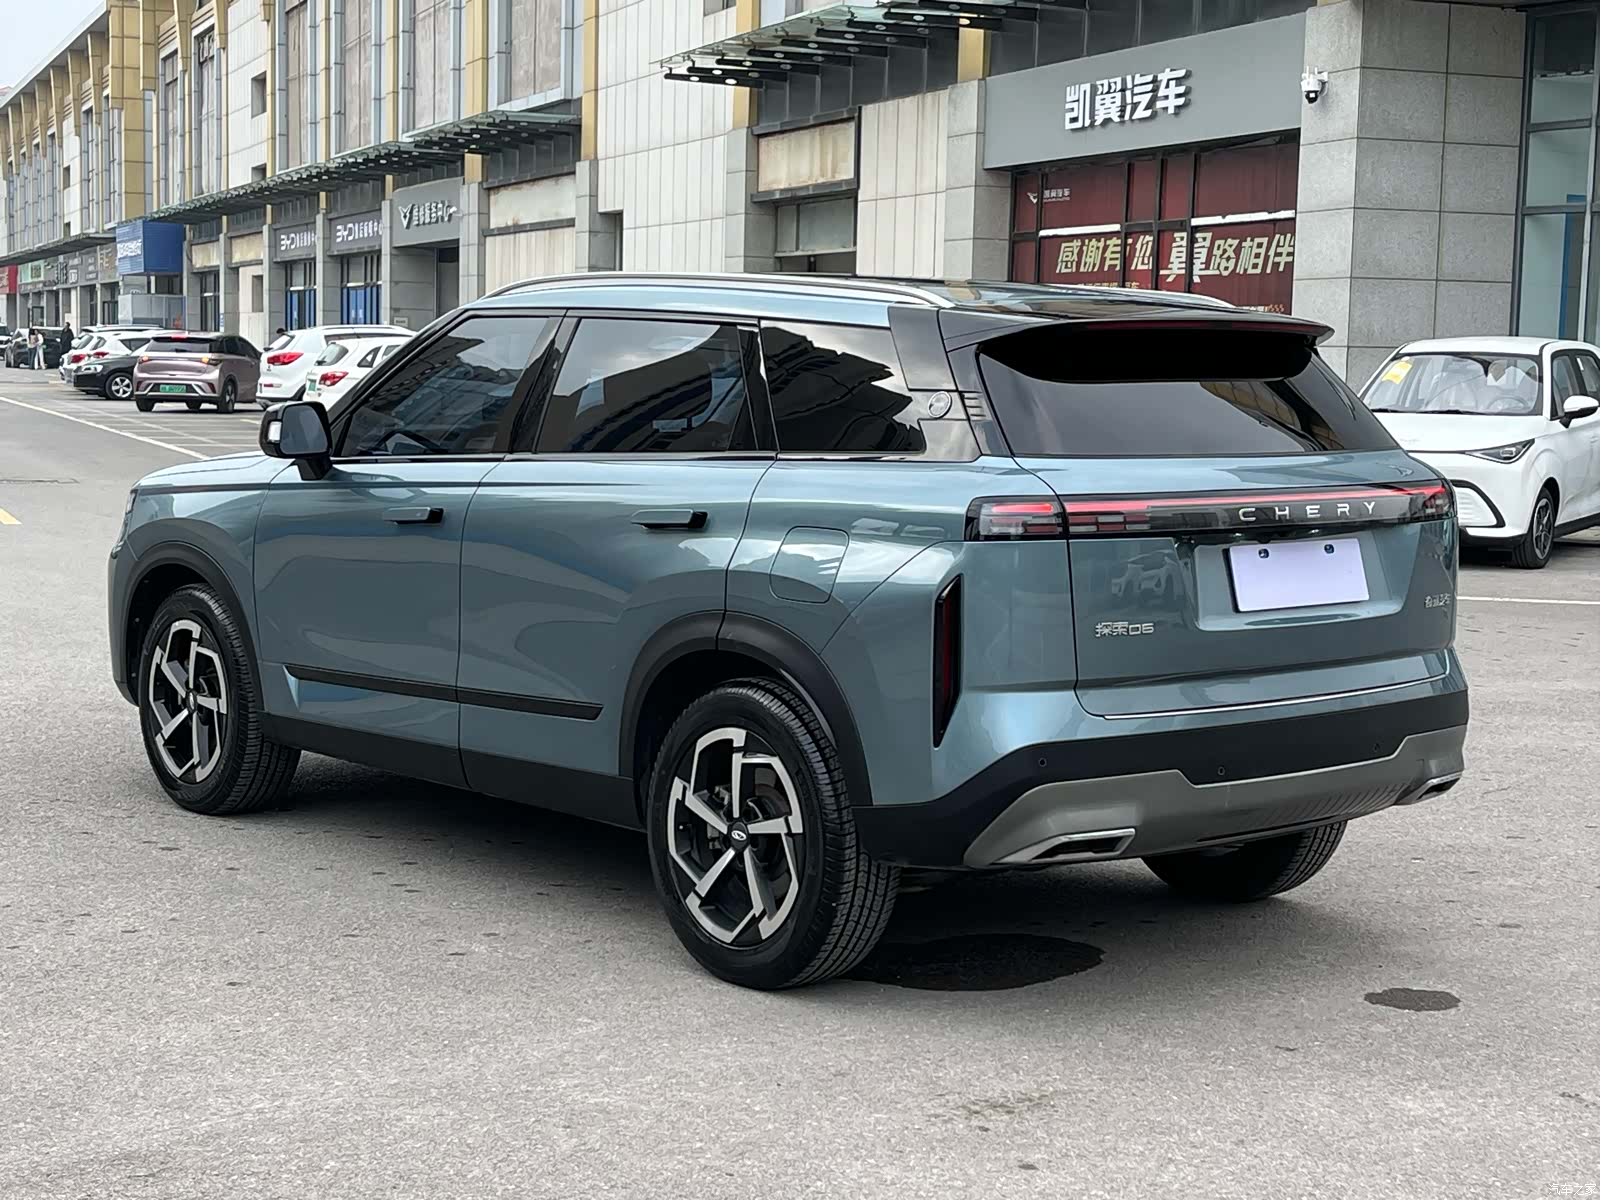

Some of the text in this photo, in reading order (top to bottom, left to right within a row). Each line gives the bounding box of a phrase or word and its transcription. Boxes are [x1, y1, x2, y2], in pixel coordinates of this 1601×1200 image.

[1064, 68, 1187, 130] 凯翼汽车
[280, 233, 297, 251] BYD
[336, 223, 355, 243] BYD
[1056, 232, 1295, 283] 感谢有您 翼路相伴
[1238, 501, 1376, 521] CHERY
